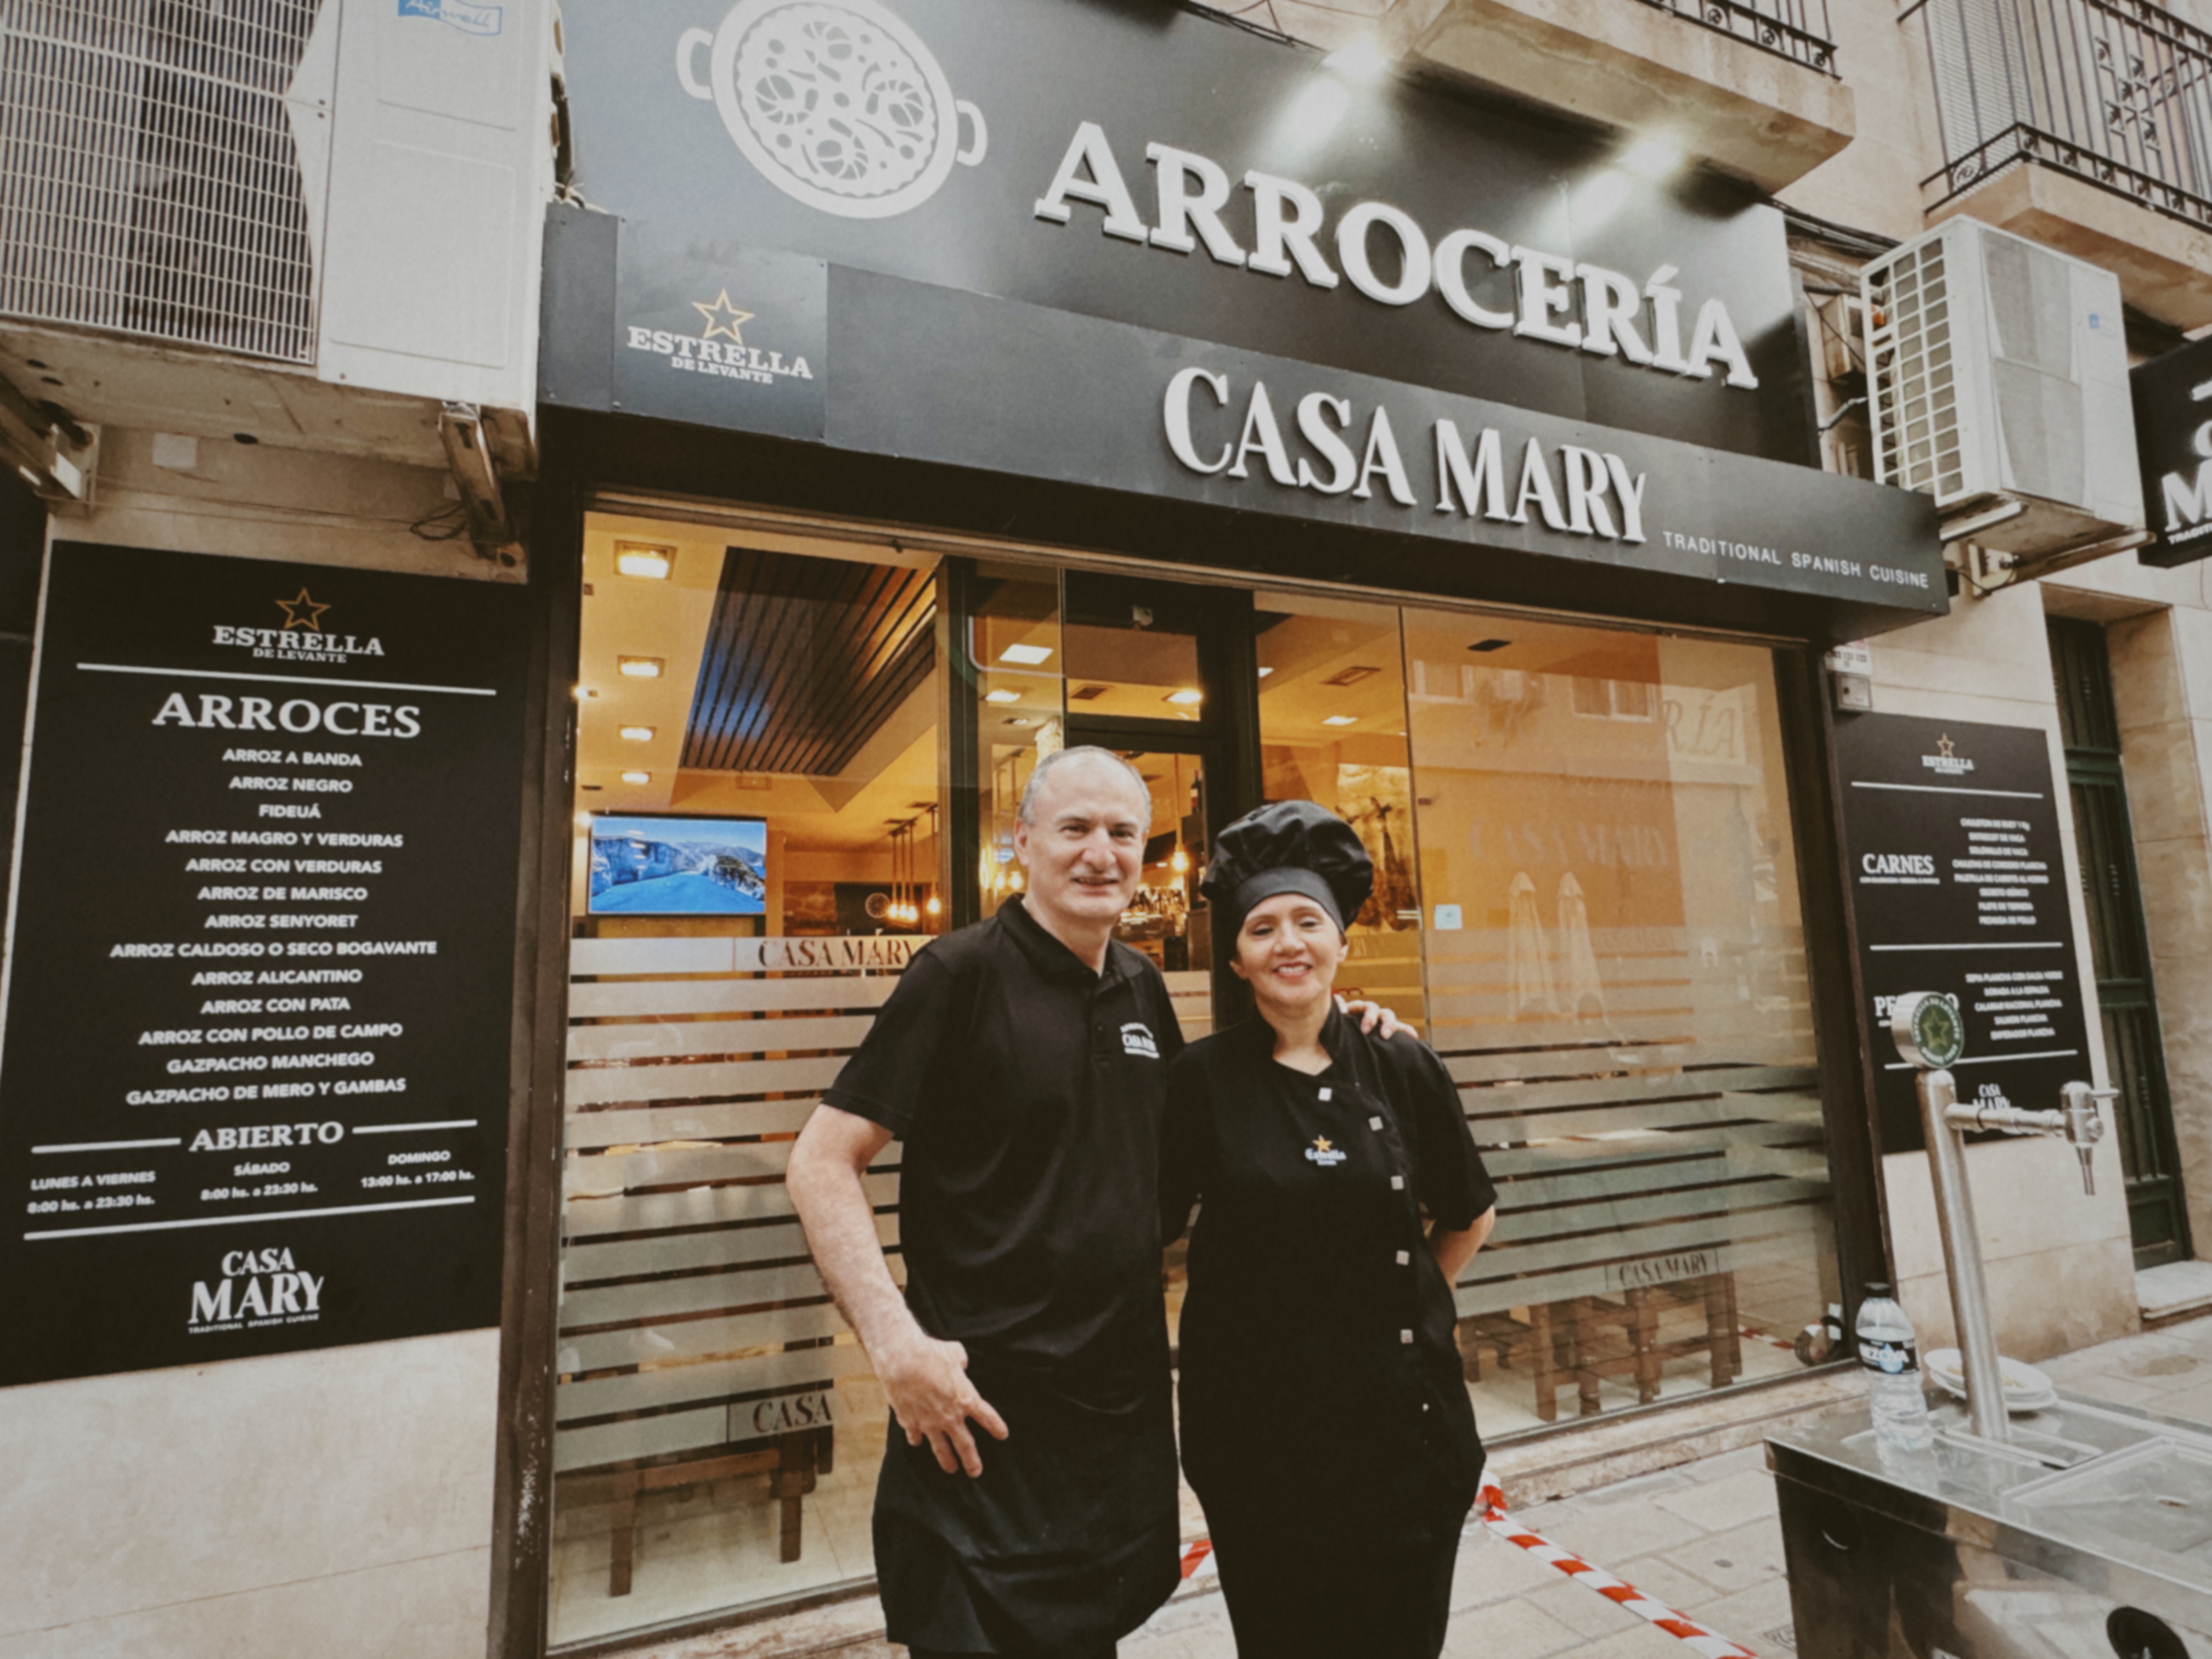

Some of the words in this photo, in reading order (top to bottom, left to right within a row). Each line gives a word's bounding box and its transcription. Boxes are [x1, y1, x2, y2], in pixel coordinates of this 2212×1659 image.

[1035, 121, 1759, 390] ARROCERÍA
[627, 326, 814, 380] ESTRELLA
[671, 356, 695, 371] DE
[697, 361, 774, 385] LEVANTE
[1163, 366, 1418, 507] CASA
[1435, 418, 1647, 544] MARY
[1663, 531, 1781, 565] TRADITIONAL
[1791, 552, 1861, 577] SPANISH
[1870, 565, 1929, 588] CUISINE
[213, 625, 385, 656] ESTRELLA
[252, 647, 273, 658] DE
[276, 650, 346, 663] LEVANTE
[152, 693, 420, 738] ARROCES
[223, 749, 281, 763] ARROZ
[285, 752, 298, 764] A
[303, 752, 362, 766] BANDA
[1922, 755, 1974, 770] ESTRELLA
[229, 776, 288, 790] ARROZ
[292, 778, 353, 792] NEGRO
[259, 803, 321, 818] FIDEUÁ
[165, 830, 227, 844] ARROZ
[231, 831, 298, 845] MAGRO
[302, 833, 313, 845] Y
[317, 833, 403, 847] VERDURAS
[185, 859, 247, 872] ARROZ
[250, 859, 290, 872] CON
[295, 860, 382, 873] VERDURAS
[1863, 854, 1934, 874] CARNES
[198, 887, 258, 900] ARROZ
[263, 887, 286, 900] DE
[291, 887, 368, 900] MARISCO
[205, 915, 266, 928] ARROZ
[269, 915, 358, 928] SENYORET
[110, 944, 174, 957] ARROZ
[178, 943, 265, 957] CALDOSO
[268, 943, 284, 956] O
[287, 942, 333, 956] SECO
[337, 941, 437, 955] BOGAVANTE
[758, 939, 833, 967] CASA
[192, 971, 253, 985] ARROZ
[257, 969, 363, 984] ALICANTINO
[201, 999, 262, 1014] ARROZ
[266, 998, 306, 1012] CON
[310, 997, 351, 1011] PATA
[138, 1030, 202, 1045] ARROZ
[206, 1028, 247, 1043] CON
[252, 1026, 309, 1041] POLLO
[313, 1025, 336, 1039] DE
[340, 1023, 403, 1038] CAMPO
[167, 1056, 268, 1074] GAZPACHO
[272, 1052, 374, 1069] MANCHEGO
[126, 1086, 230, 1105] GAZPACHO
[234, 1085, 258, 1099] DE
[262, 1082, 315, 1098] MERO
[319, 1082, 330, 1095] Y
[334, 1078, 406, 1094] GAMBAS
[1979, 1084, 2001, 1097] CASA
[189, 1121, 343, 1152] ABIERTO
[388, 1150, 450, 1165] DOMINGO
[234, 1162, 290, 1176] SÁBADO
[31, 1176, 78, 1190] LUNES
[81, 1176, 93, 1187] A
[96, 1171, 155, 1185] VIERNES
[222, 1246, 295, 1277] CASA
[188, 1271, 324, 1324] MARY
[188, 1322, 243, 1334] TRADITIONAL
[247, 1318, 283, 1328] SPANISH
[286, 1313, 319, 1323] CUISINE
[753, 1393, 832, 1432] CASA
